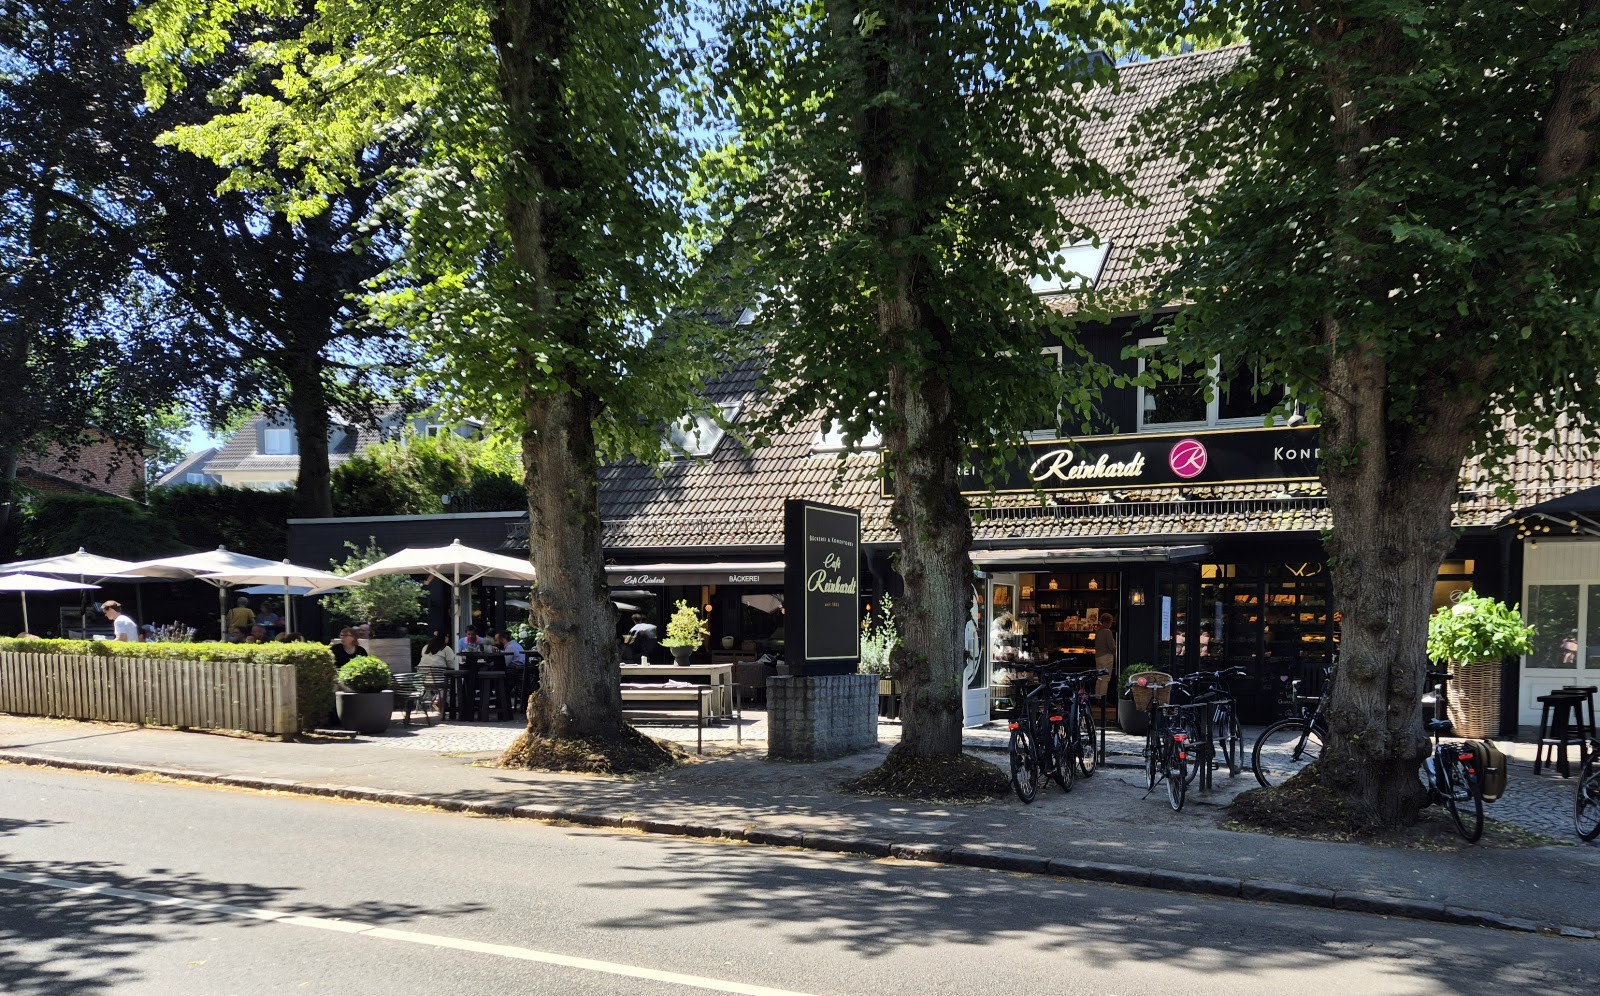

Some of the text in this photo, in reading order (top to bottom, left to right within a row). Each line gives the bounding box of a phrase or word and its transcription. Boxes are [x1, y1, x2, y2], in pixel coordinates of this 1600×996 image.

[1029, 449, 1146, 481] Reinhardt
[638, 574, 666, 585] Reinhardt
[807, 569, 856, 594] Reinhardt
